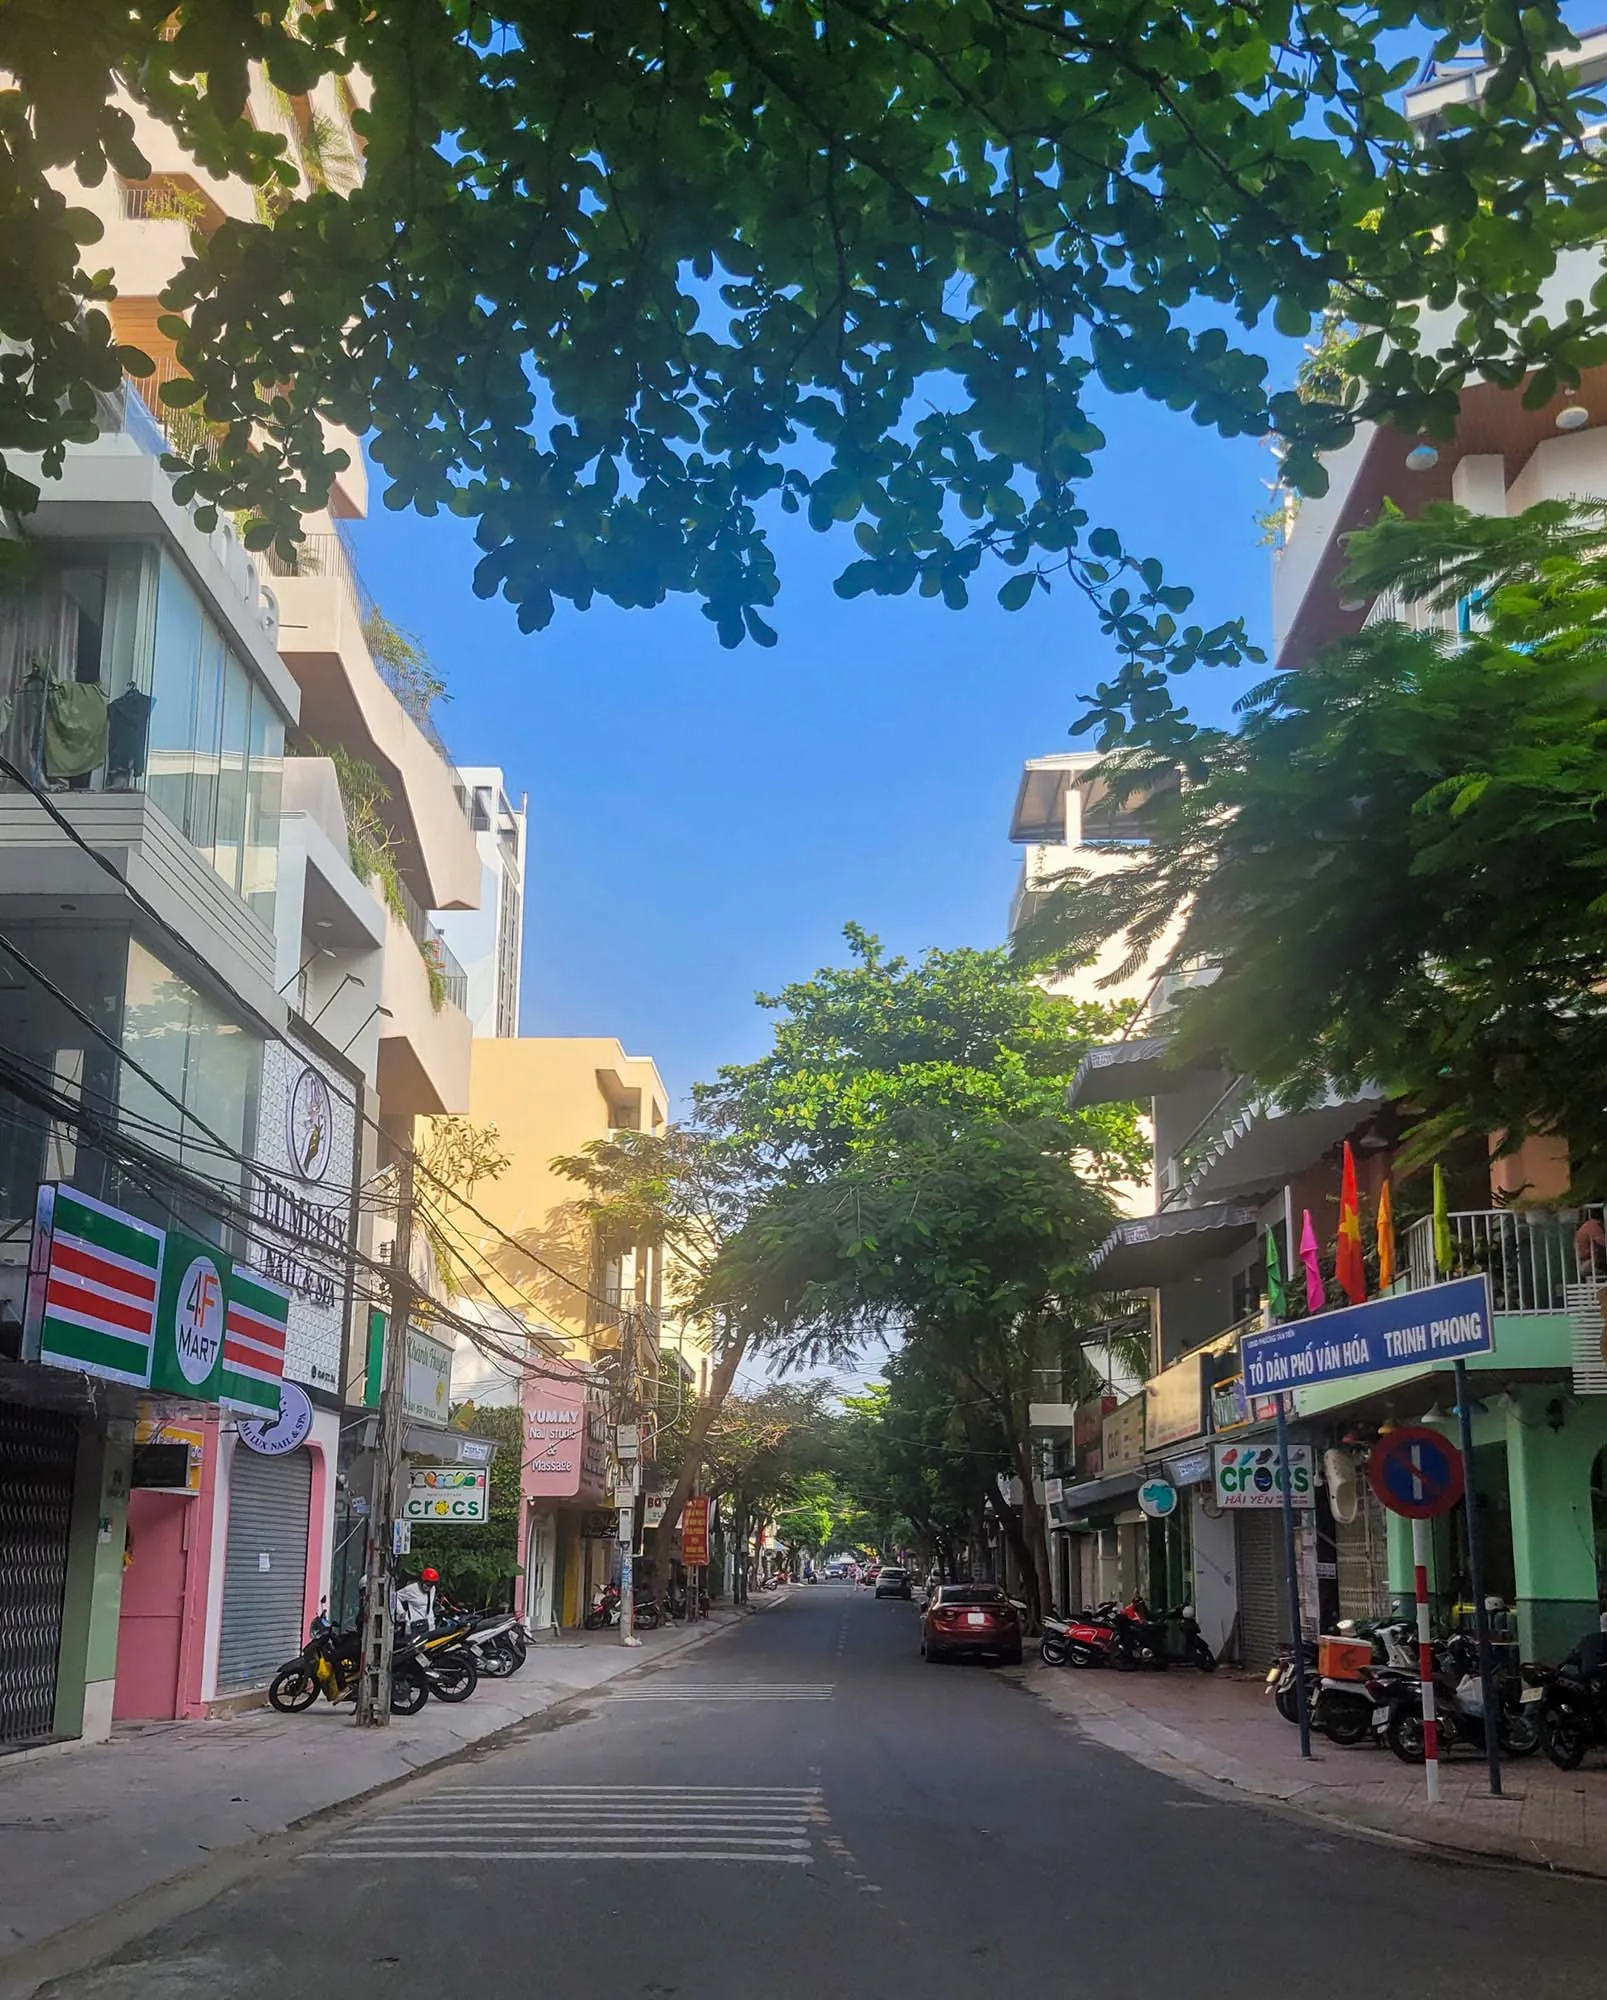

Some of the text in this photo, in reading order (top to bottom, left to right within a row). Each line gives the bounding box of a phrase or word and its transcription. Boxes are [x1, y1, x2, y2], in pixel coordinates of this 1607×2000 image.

[186, 1271, 218, 1328] 4F
[178, 1324, 217, 1364] MART
[1249, 1312, 1482, 1386] TỔ DÂN PHỐ VĂN HÓA TRỊNH PHONG
[528, 1410, 579, 1424] YUMMY
[241, 1412, 307, 1451] MI LUX NAIL & SPA
[529, 1426, 577, 1440] Nail studio
[546, 1444, 557, 1456] &
[532, 1460, 573, 1473] Massage
[408, 1500, 480, 1516] crocs
